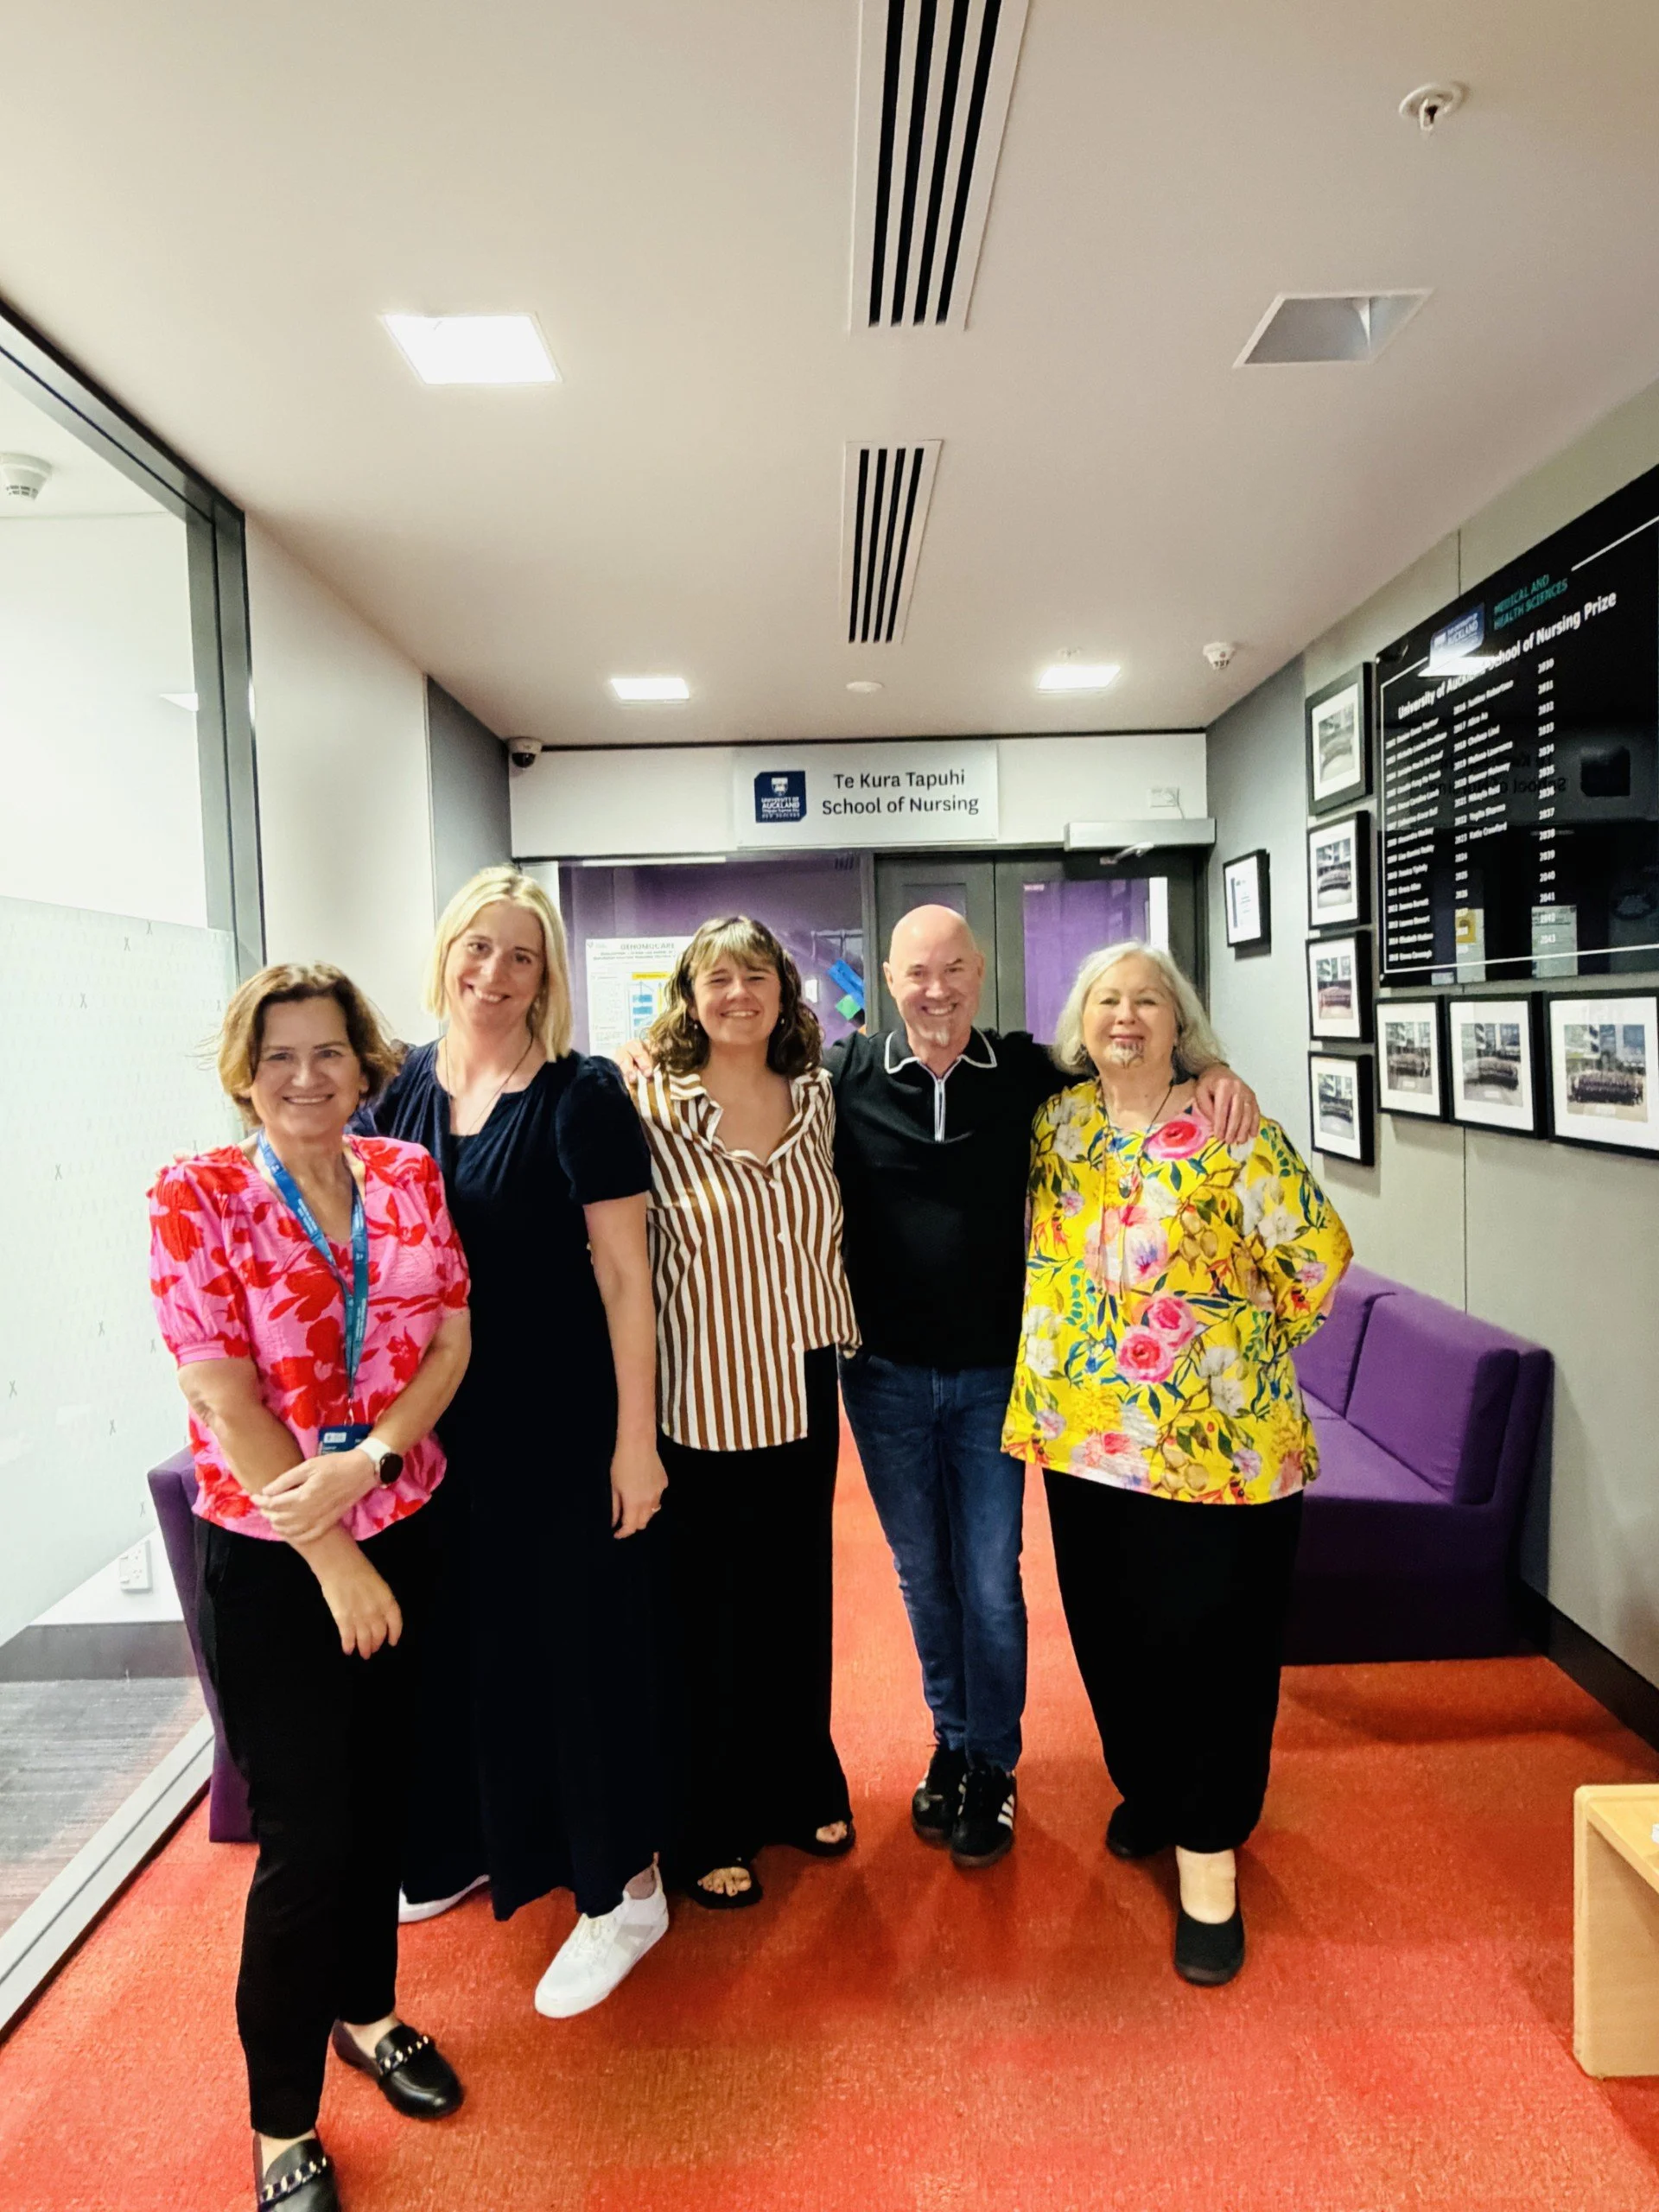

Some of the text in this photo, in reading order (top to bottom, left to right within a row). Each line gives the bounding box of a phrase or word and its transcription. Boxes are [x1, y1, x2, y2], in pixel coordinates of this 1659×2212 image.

[1493, 574, 1549, 615] MEDICAL AND
[1493, 603, 1524, 631] HEALTH
[1526, 578, 1568, 612] SCIENCES
[1397, 690, 1435, 720] University
[1436, 681, 1446, 699] of
[1446, 659, 1486, 694] Auckl
[1522, 632, 1535, 652] of
[1536, 611, 1581, 645] Nursing
[1584, 592, 1617, 621] Prize
[834, 769, 965, 791] Te Kura Tapuhi
[823, 795, 979, 816] School of Nursing
[1539, 892, 1555, 904] 2041
